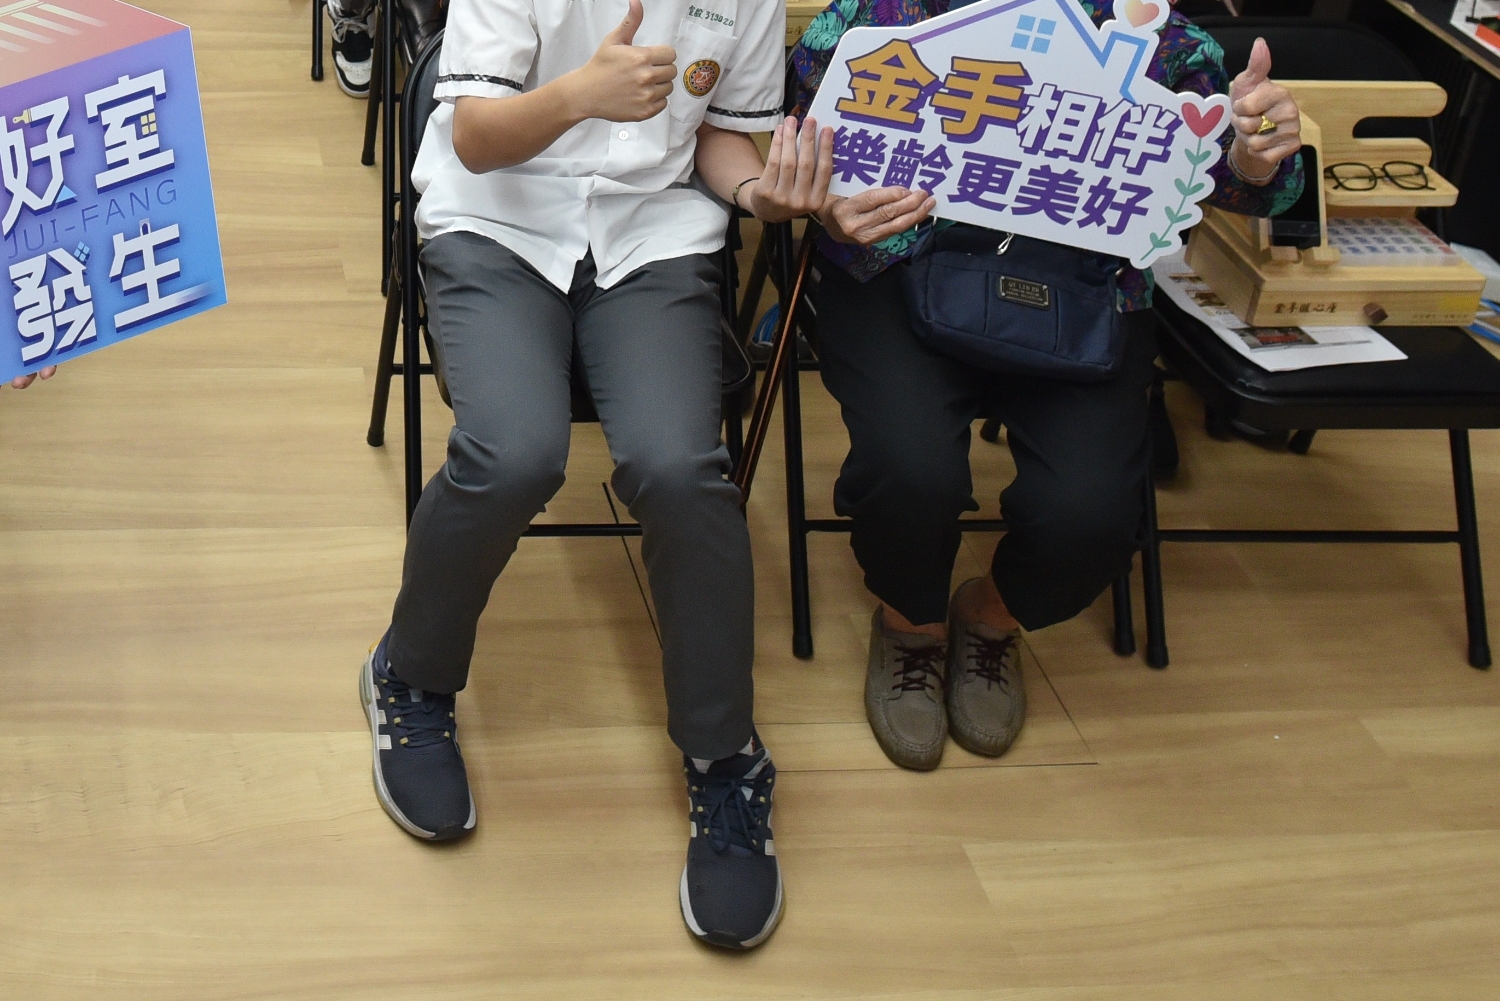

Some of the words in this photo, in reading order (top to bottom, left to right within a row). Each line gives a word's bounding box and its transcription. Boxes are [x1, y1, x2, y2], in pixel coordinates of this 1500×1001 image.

[836, 39, 1179, 180] 金手相伴
[7, 178, 178, 259] JUI-FANG
[831, 126, 1155, 236] 樂齡更美好
[9, 222, 212, 364] 發生
